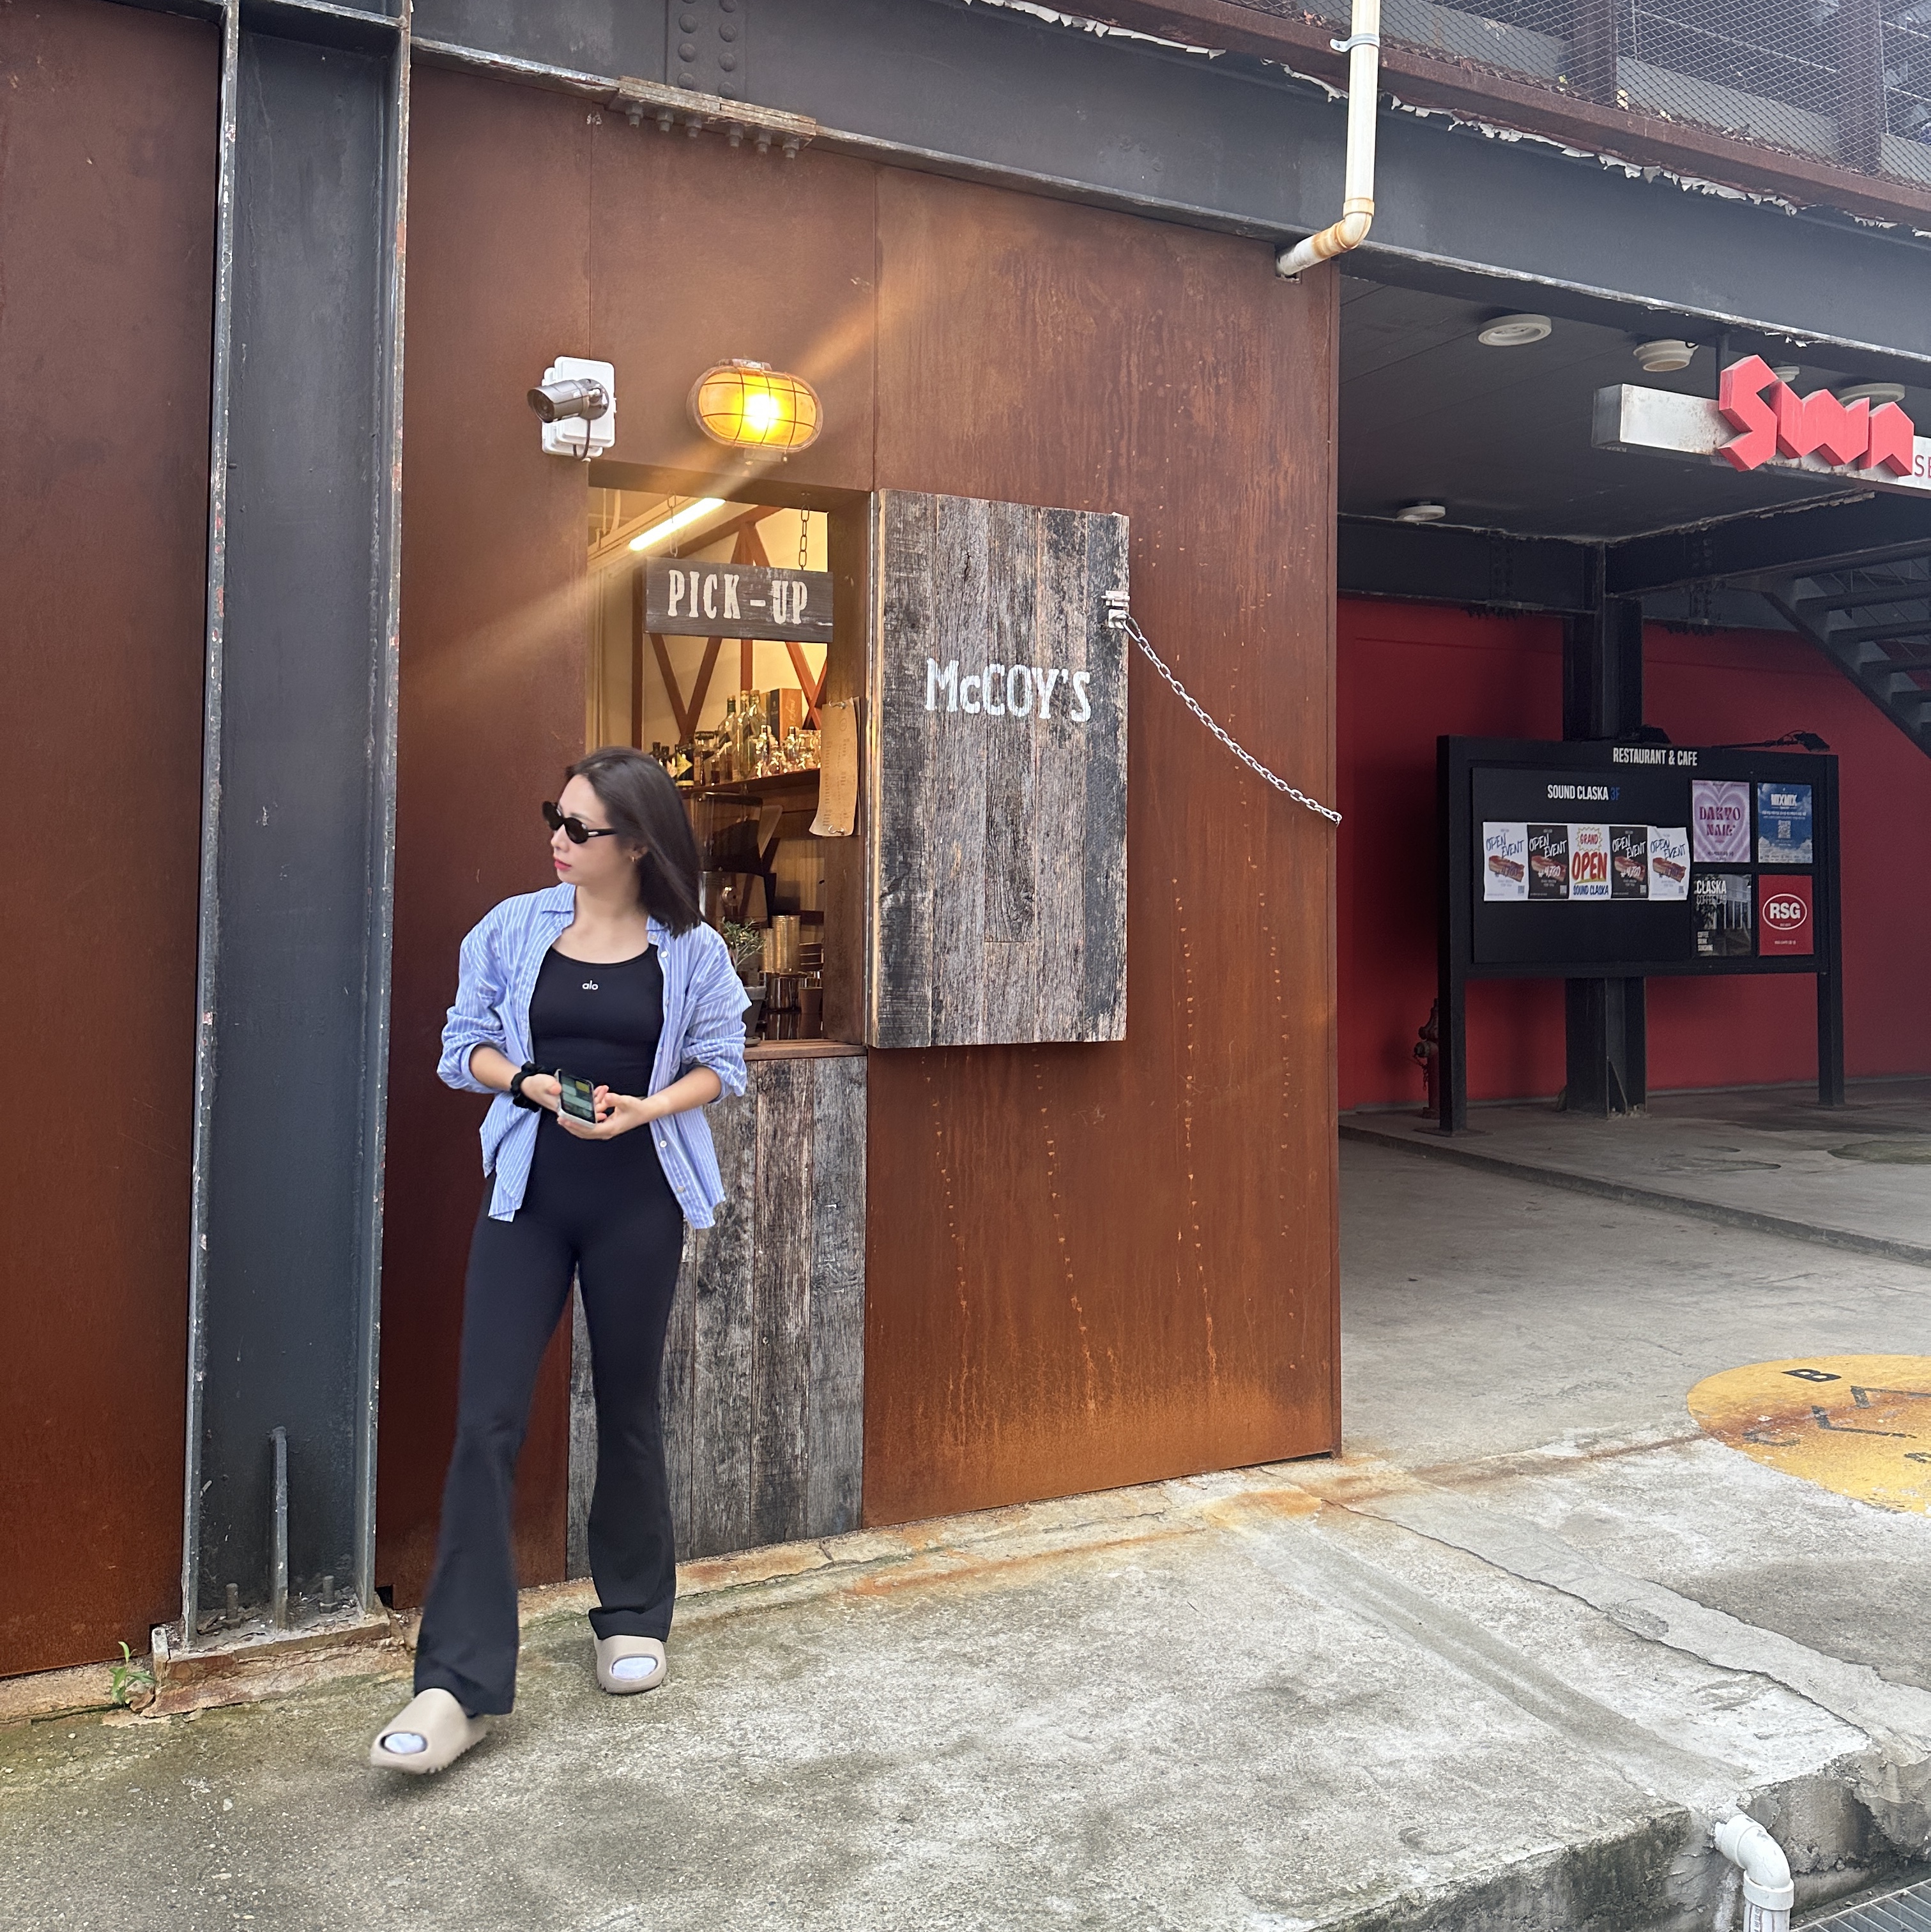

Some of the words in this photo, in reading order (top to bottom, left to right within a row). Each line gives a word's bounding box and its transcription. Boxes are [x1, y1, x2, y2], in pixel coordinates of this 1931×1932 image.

[668, 569, 808, 625] PICK-UP
[926, 658, 1092, 722] McCOY'S
[1613, 747, 1667, 764] RESTAURANT
[1668, 750, 1675, 765] &
[1677, 750, 1698, 766] CAFE
[1547, 784, 1575, 799] SOUND
[1576, 786, 1608, 800] CLASKA
[1699, 807, 1741, 821] DAKYO
[1486, 833, 1506, 851] OPEN
[1529, 833, 1550, 851] OPEN
[1580, 833, 1598, 844] GRAND
[1612, 834, 1631, 852] OPEN
[1650, 838, 1670, 853] OPEN
[1502, 840, 1524, 858] EVENT
[1545, 840, 1567, 858] EVENT
[1626, 841, 1646, 859] EVENT
[1663, 844, 1686, 859] EVENT
[1571, 851, 1608, 881] OPEN
[1573, 885, 1589, 895] SOUND
[1590, 885, 1609, 895] CLASKA
[1697, 880, 1727, 894] CLASKA
[1769, 902, 1801, 919] RSG
[582, 980, 599, 990] alo
